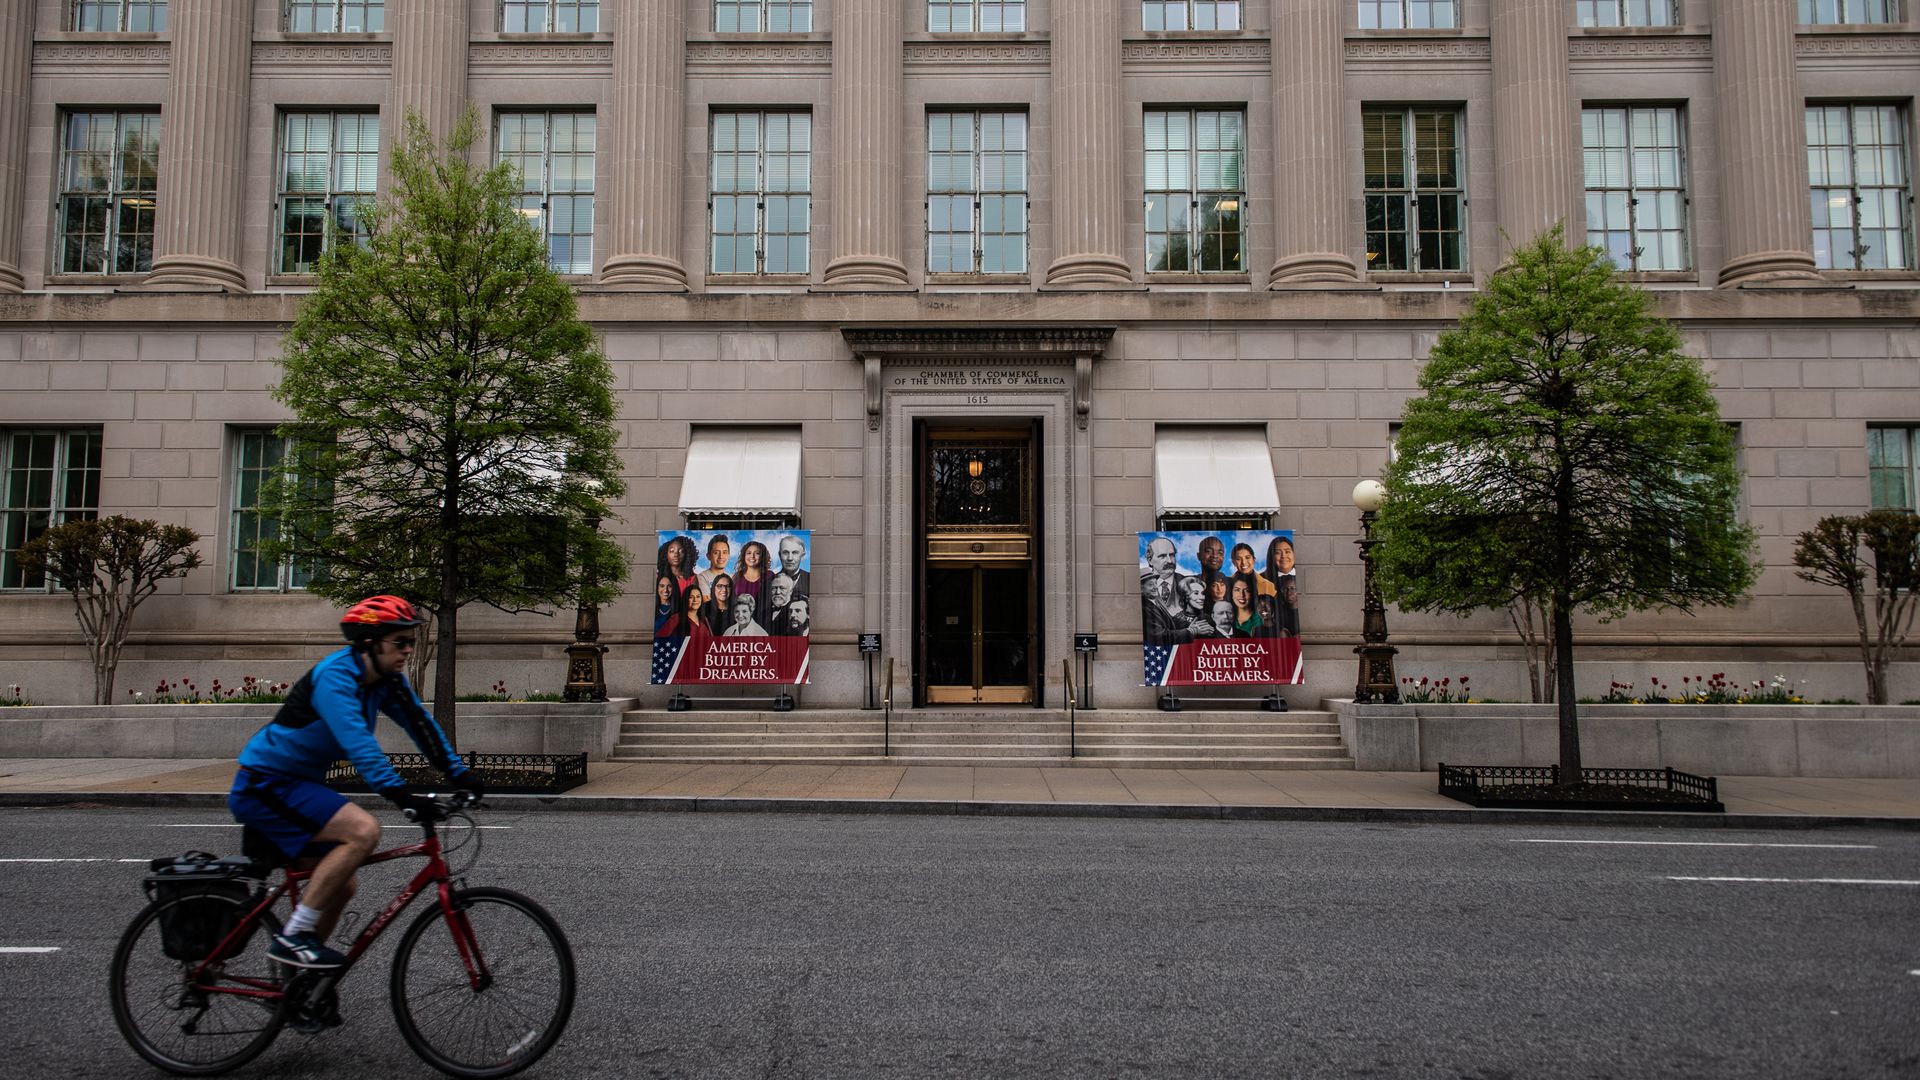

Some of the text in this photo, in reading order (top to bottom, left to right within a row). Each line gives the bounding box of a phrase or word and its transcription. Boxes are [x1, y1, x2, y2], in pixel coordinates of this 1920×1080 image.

[986, 370, 1040, 378] COMMERCE
[1024, 377, 1066, 385] AMERICA
[967, 396, 989, 404] 1615
[707, 641, 776, 653] AMERICA.
[1200, 643, 1269, 655] AMERICA.
[704, 654, 768, 667] BUILT BY
[1197, 656, 1261, 669] BUILT BY
[699, 667, 779, 680] DREAMERS.
[1192, 669, 1274, 682] DREAMERS.
